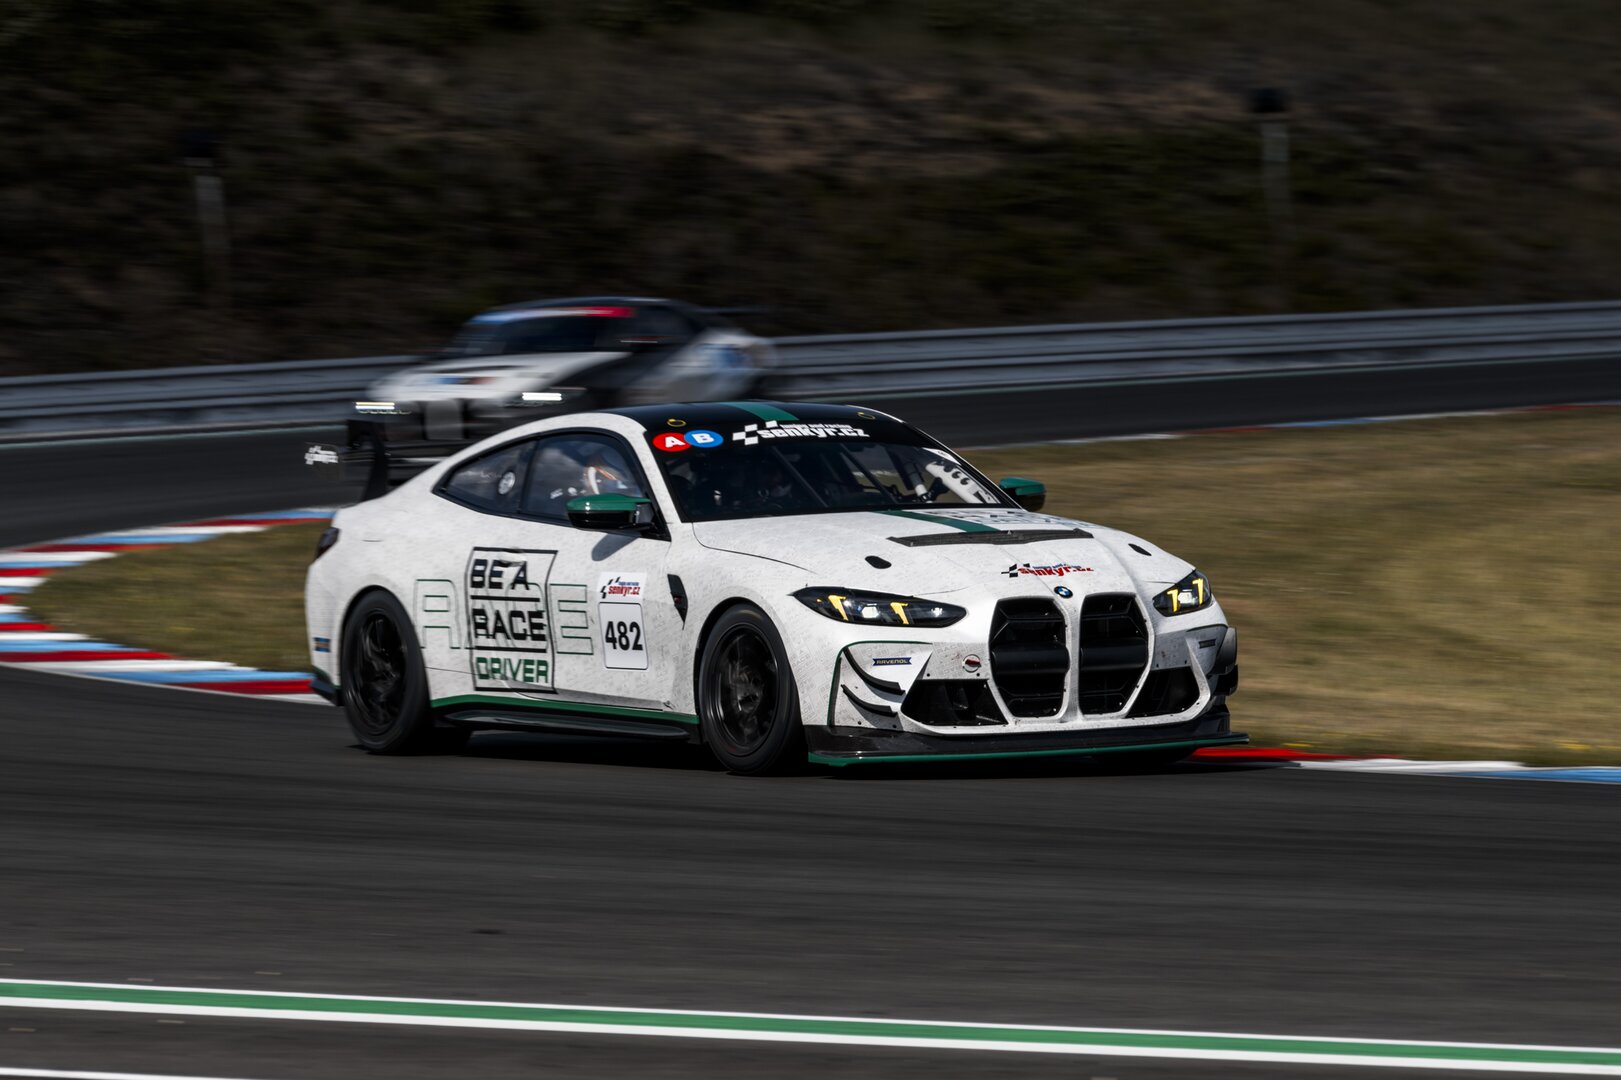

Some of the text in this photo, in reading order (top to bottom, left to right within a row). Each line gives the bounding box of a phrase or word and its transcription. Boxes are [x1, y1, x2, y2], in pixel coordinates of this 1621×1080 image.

[665, 433, 714, 448] A B
[757, 426, 870, 438] senkyr.cz
[472, 608, 547, 641] RACE
[605, 621, 644, 651] 482
[476, 657, 549, 684] DRIVER
